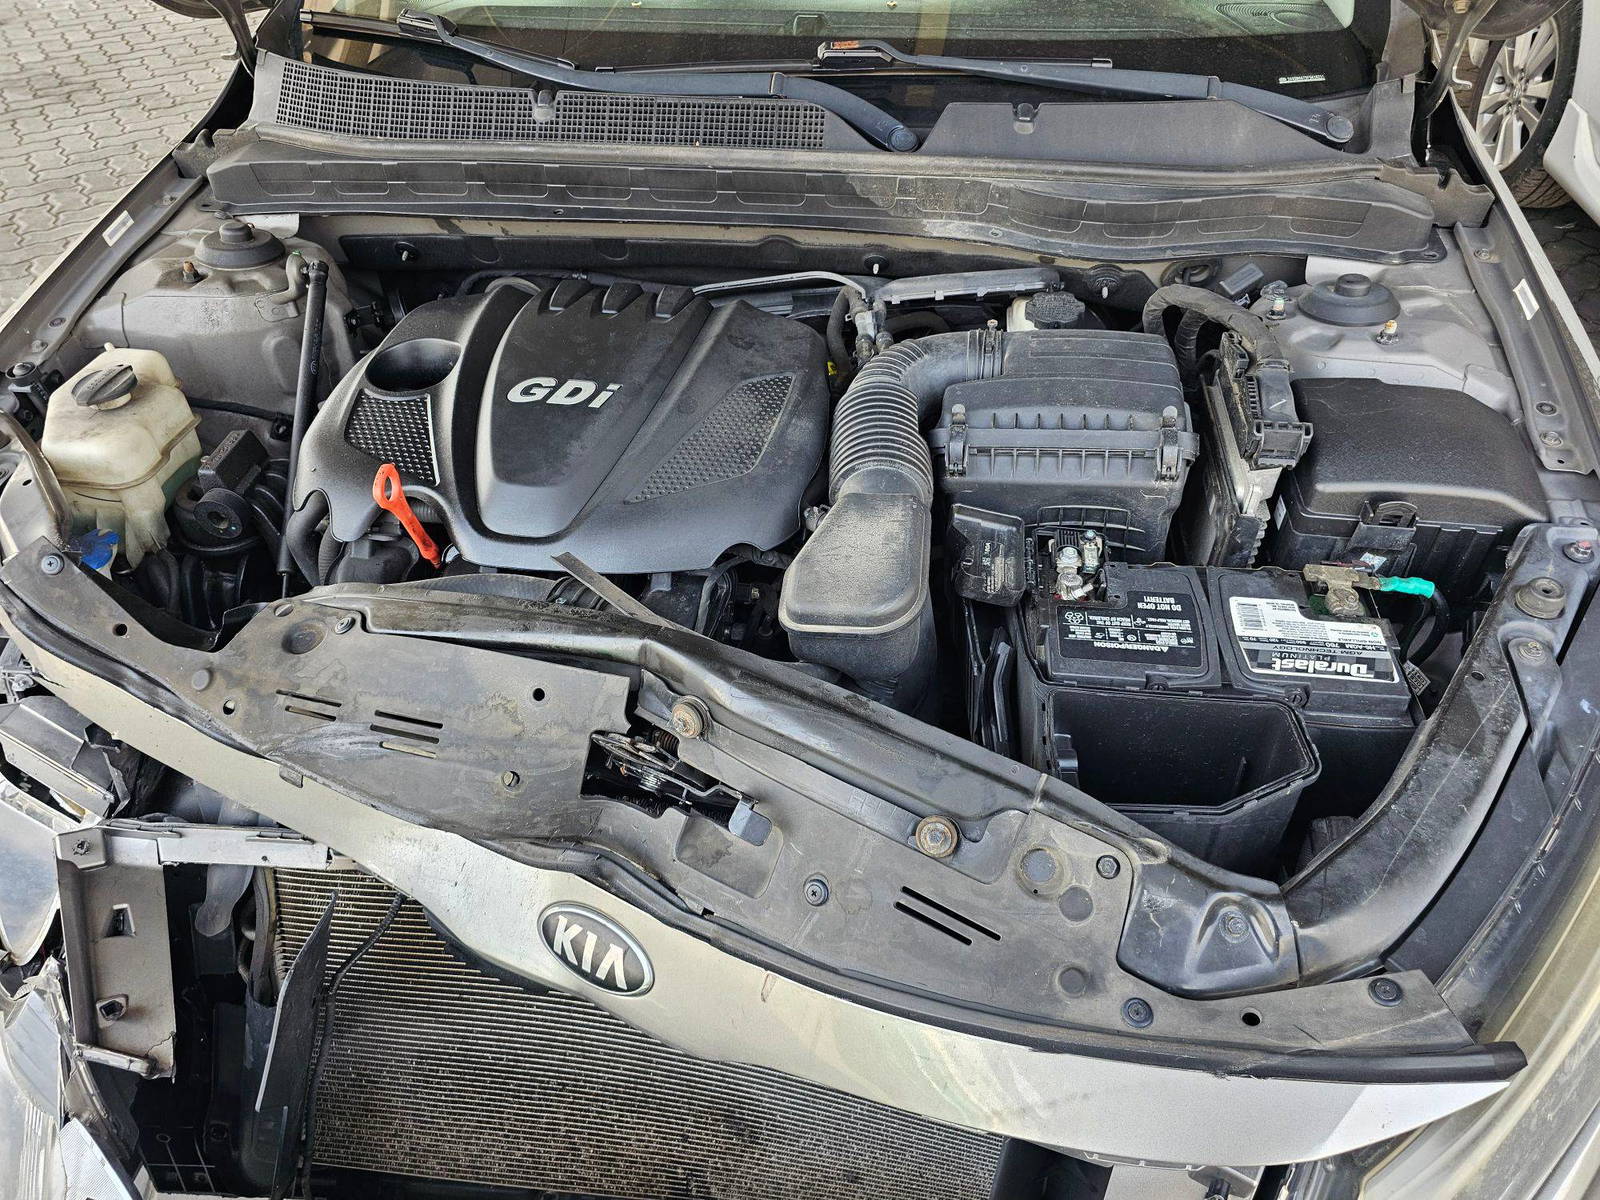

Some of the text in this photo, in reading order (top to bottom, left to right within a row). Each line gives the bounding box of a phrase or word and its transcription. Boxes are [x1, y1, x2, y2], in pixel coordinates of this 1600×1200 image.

[506, 377, 623, 409] GDi
[1137, 601, 1182, 611] DO NOT OPEN
[1271, 652, 1331, 661] PLATINUM
[1272, 645, 1337, 654] TECHNOLOGY
[1271, 658, 1375, 679] Duralast
[553, 915, 628, 990] KIA
